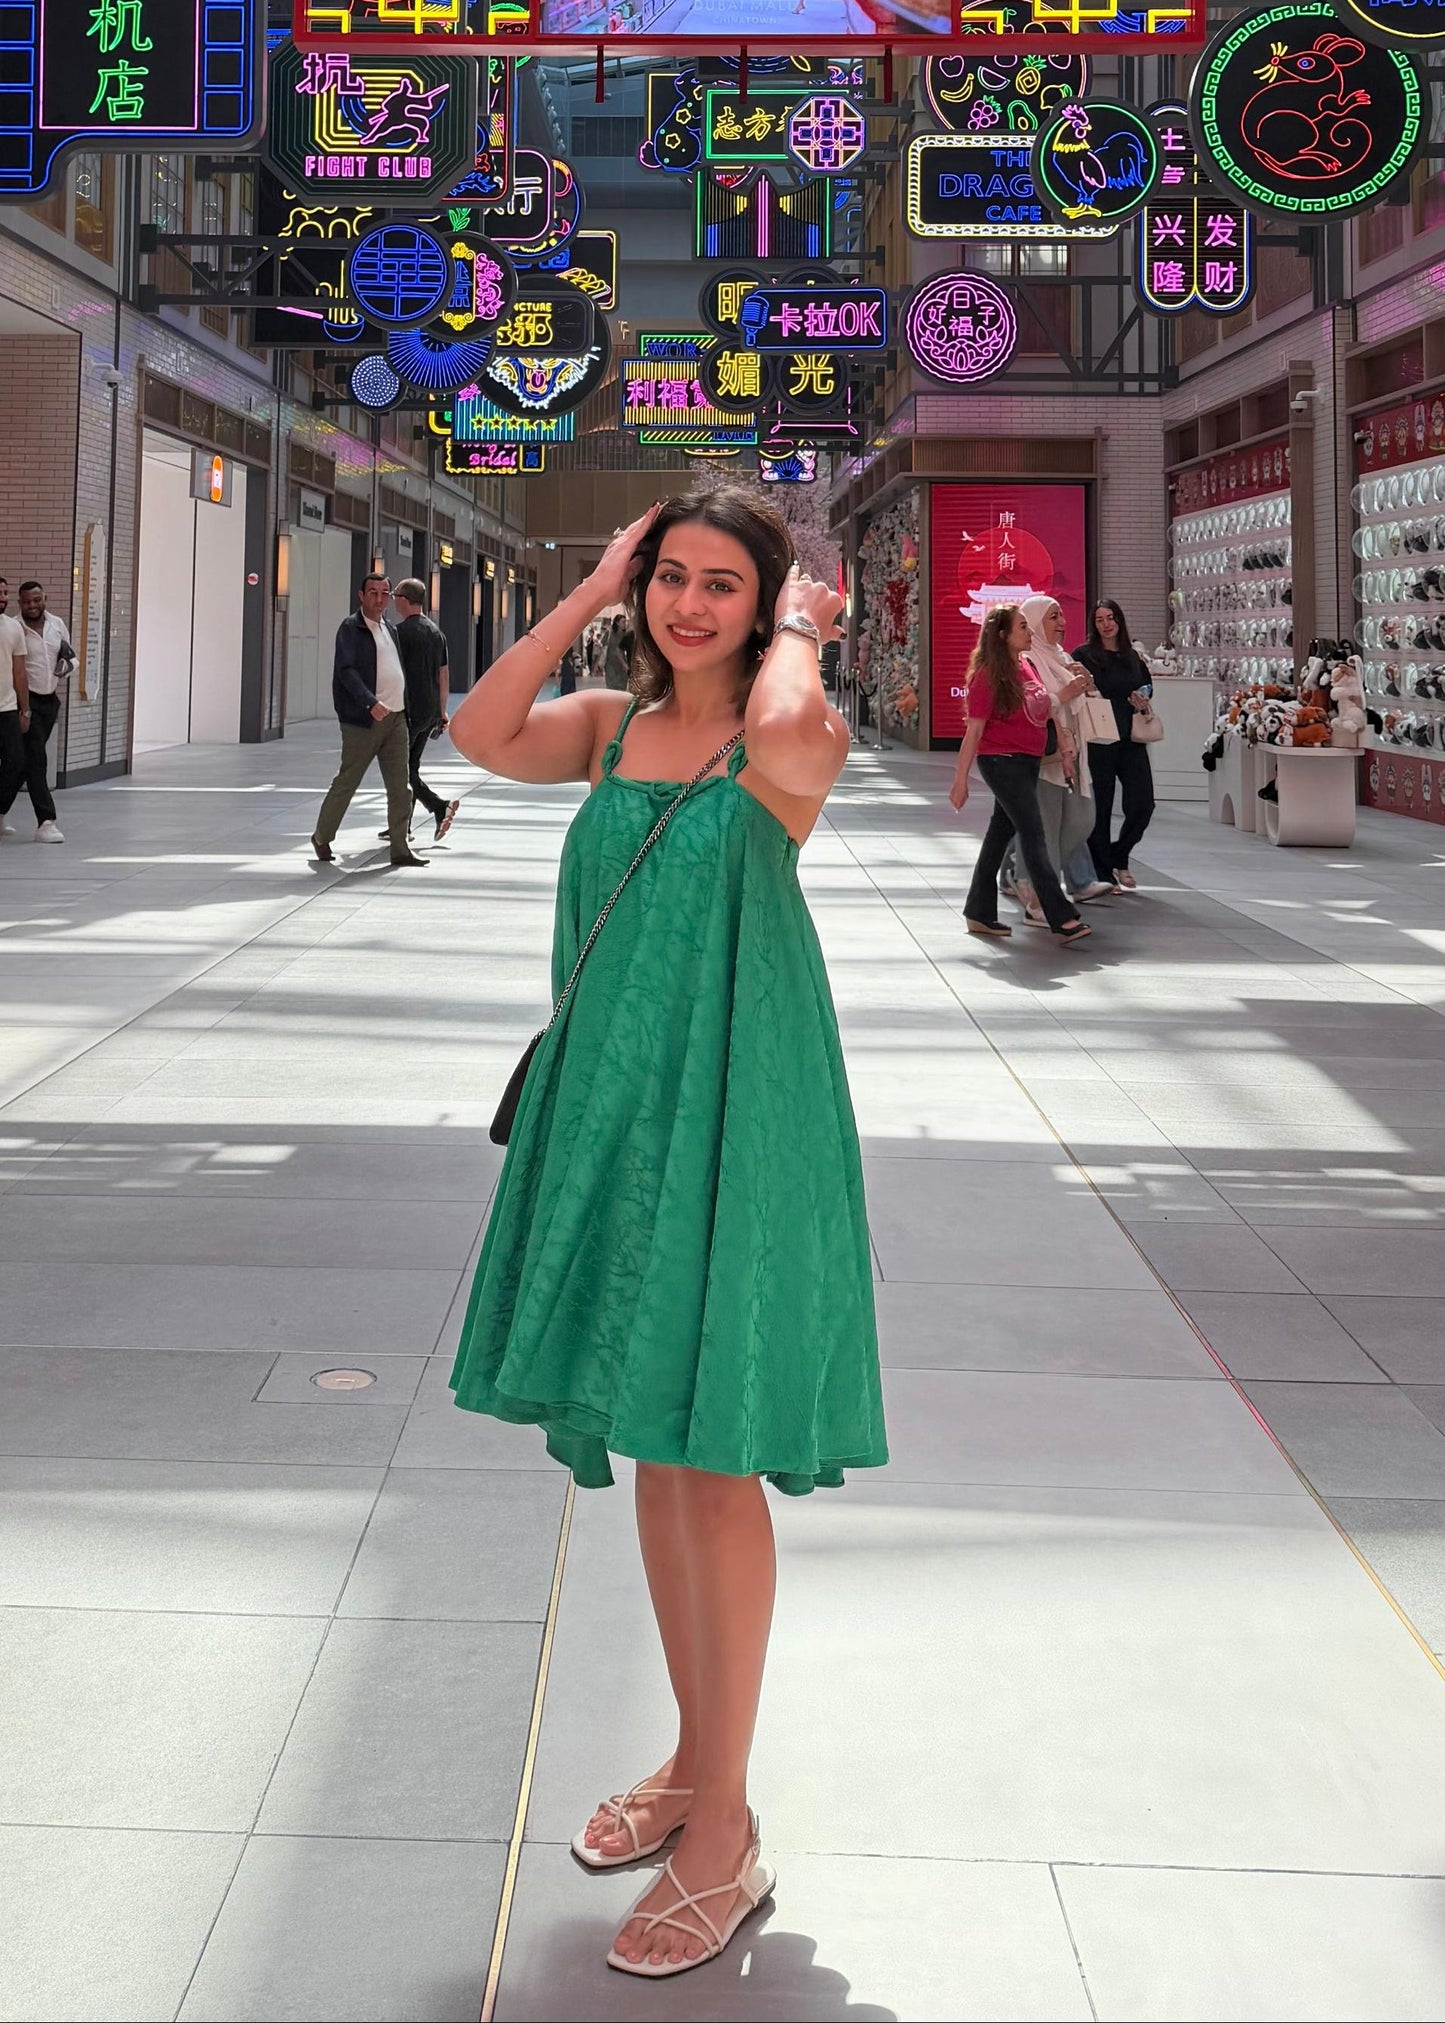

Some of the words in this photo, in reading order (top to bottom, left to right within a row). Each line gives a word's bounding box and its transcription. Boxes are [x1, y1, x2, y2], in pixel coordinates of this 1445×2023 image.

[694, 0, 744, 11] DUBAI
[750, 0, 796, 11] MALL
[712, 16, 778, 25] CHINATOWN
[86, 0, 154, 121] 机店
[713, 106, 794, 141] 志方
[305, 156, 368, 177] FIGHT
[378, 156, 432, 178] CLUB
[990, 150, 1031, 167] TH
[939, 174, 1034, 198] DRAG
[985, 205, 1042, 221] CAFE
[769, 301, 882, 338] 卡拉OK
[645, 341, 708, 357] WOR
[469, 450, 518, 467] Bridal
[997, 510, 1017, 571] 唐人街
[950, 686, 969, 698] Du
